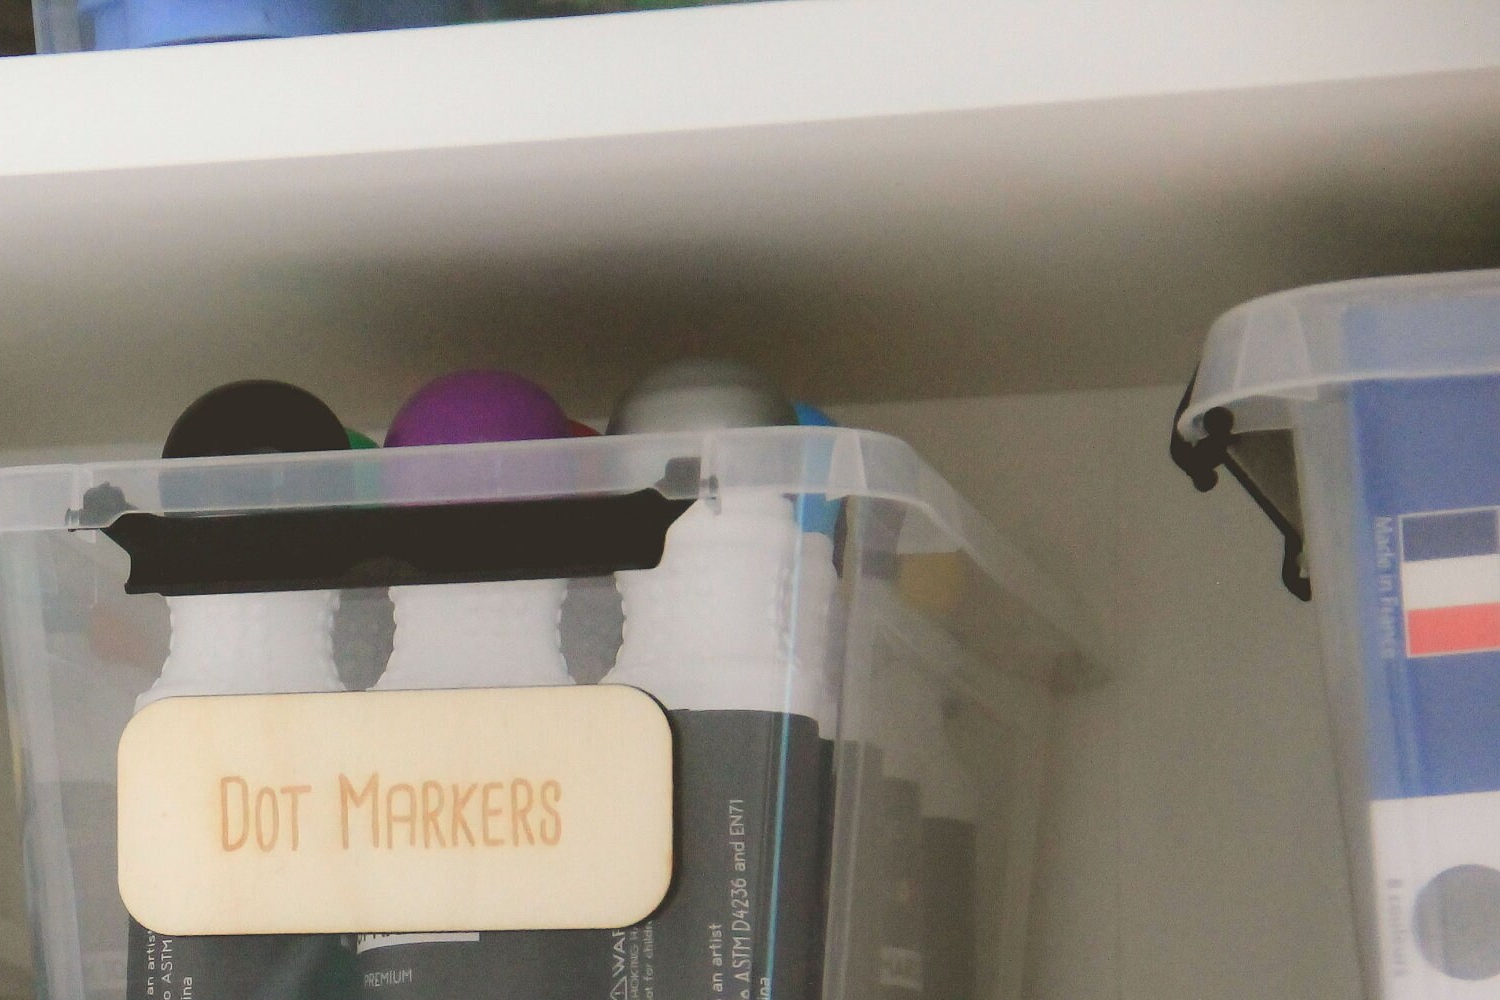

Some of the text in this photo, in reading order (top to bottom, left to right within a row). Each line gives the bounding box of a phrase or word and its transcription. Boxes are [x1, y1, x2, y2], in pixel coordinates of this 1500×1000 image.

[219, 773, 563, 853] DOT MARKERS
[729, 799, 745, 836] EN71
[729, 841, 746, 872] and
[731, 878, 751, 932] D4236
[161, 939, 173, 984] ASTM
[709, 922, 723, 967] artist
[732, 936, 750, 983] ASTM
[147, 976, 154, 996] an
[364, 968, 413, 988] PREMIUM
[643, 965, 654, 980] for
[712, 972, 724, 992] an
